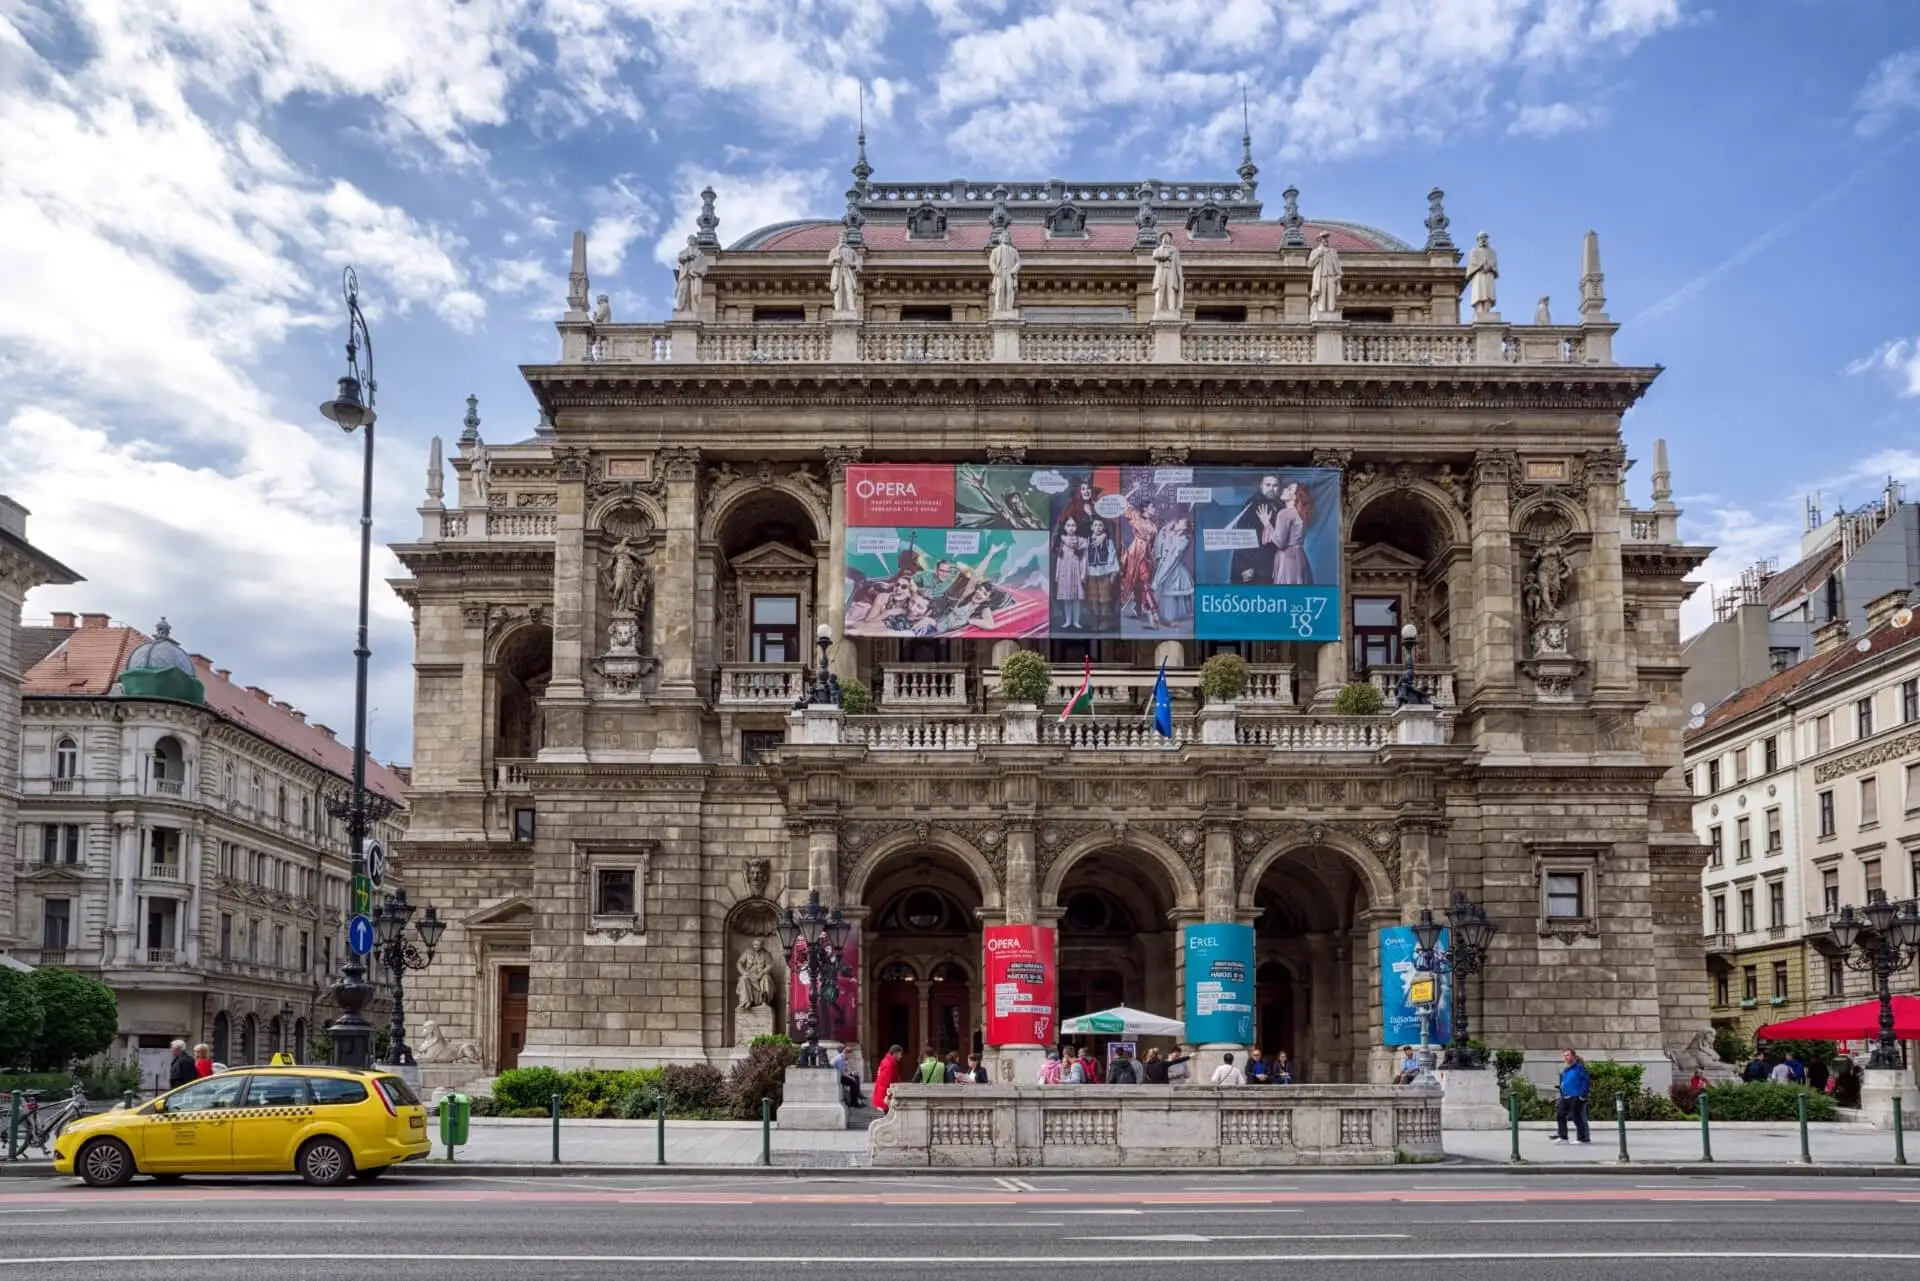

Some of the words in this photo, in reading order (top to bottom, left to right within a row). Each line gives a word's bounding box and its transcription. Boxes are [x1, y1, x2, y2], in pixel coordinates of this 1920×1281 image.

[856, 480, 917, 498] OPERA
[1201, 593, 1287, 613] ElsőSorban
[987, 938, 1021, 951] OPERA
